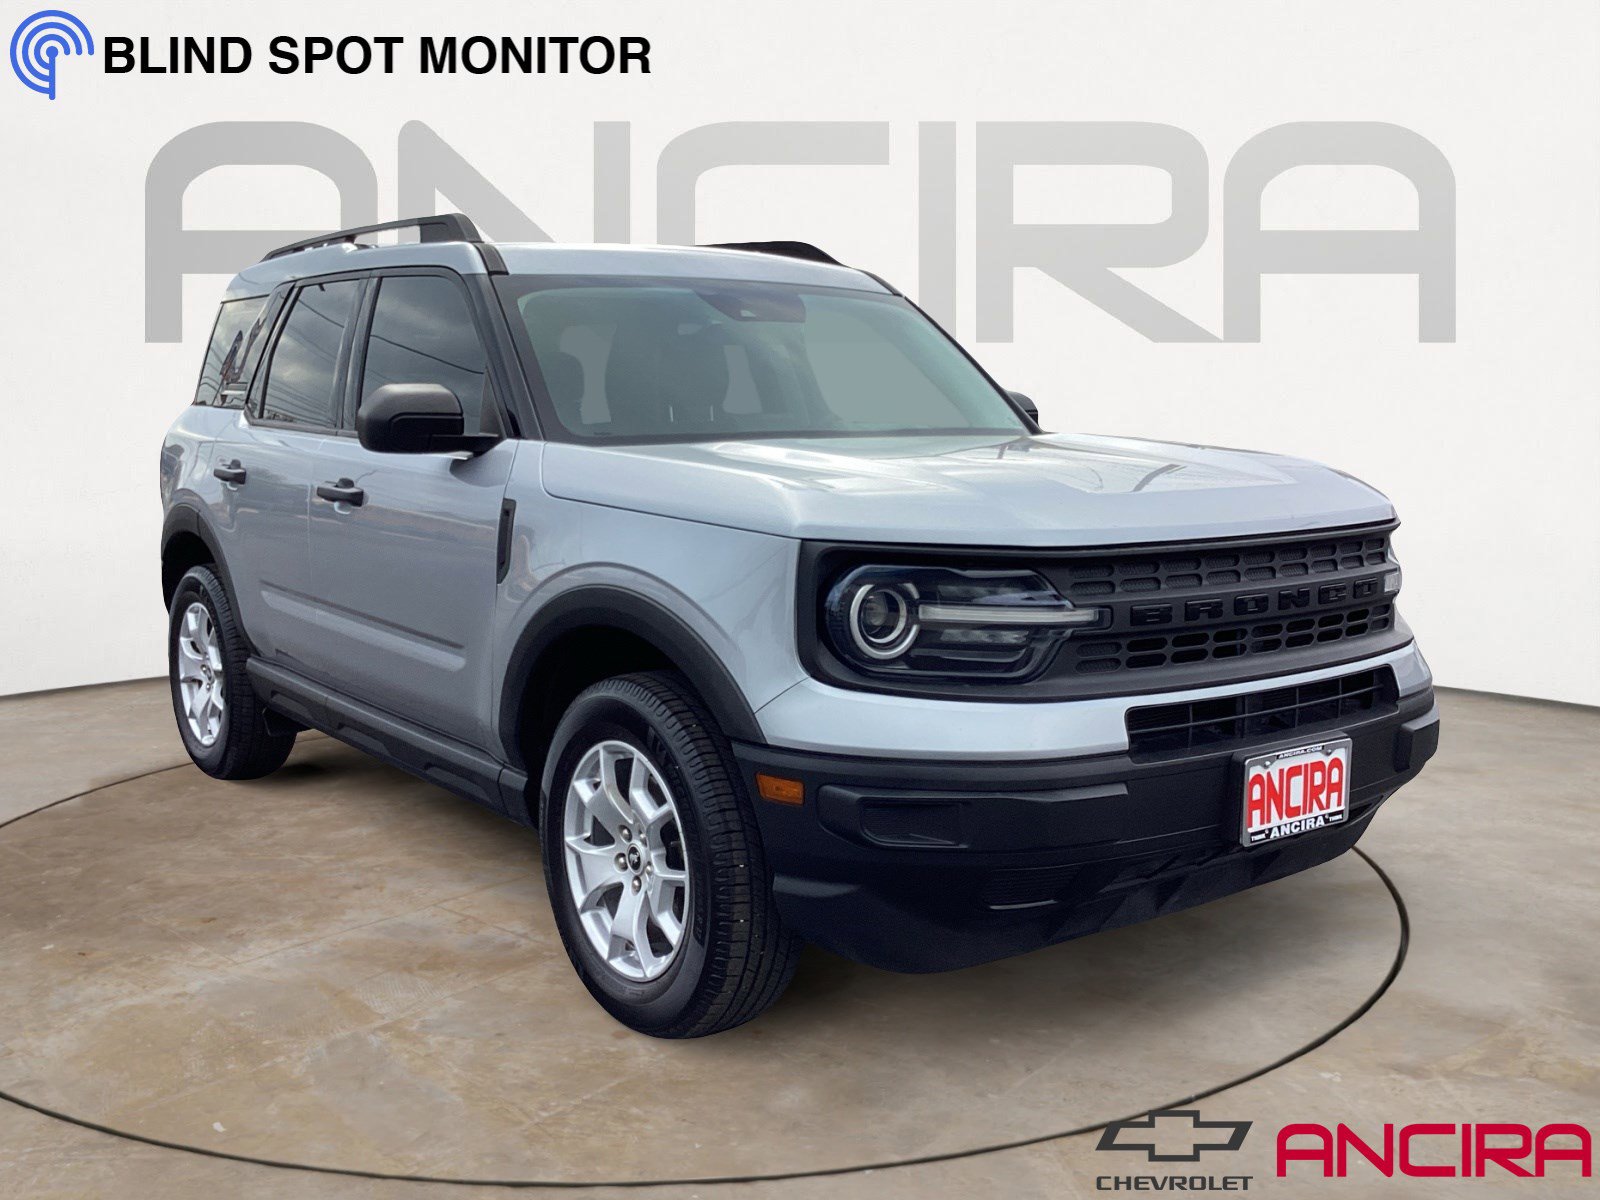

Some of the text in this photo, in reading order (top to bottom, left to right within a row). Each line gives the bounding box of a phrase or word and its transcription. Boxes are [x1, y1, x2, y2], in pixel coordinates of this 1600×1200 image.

[145, 120, 1456, 343] ANCIRA
[1131, 577, 1378, 627] BRONCO
[1247, 757, 1343, 828] ANCIRA
[1269, 815, 1325, 839] ANCIRA
